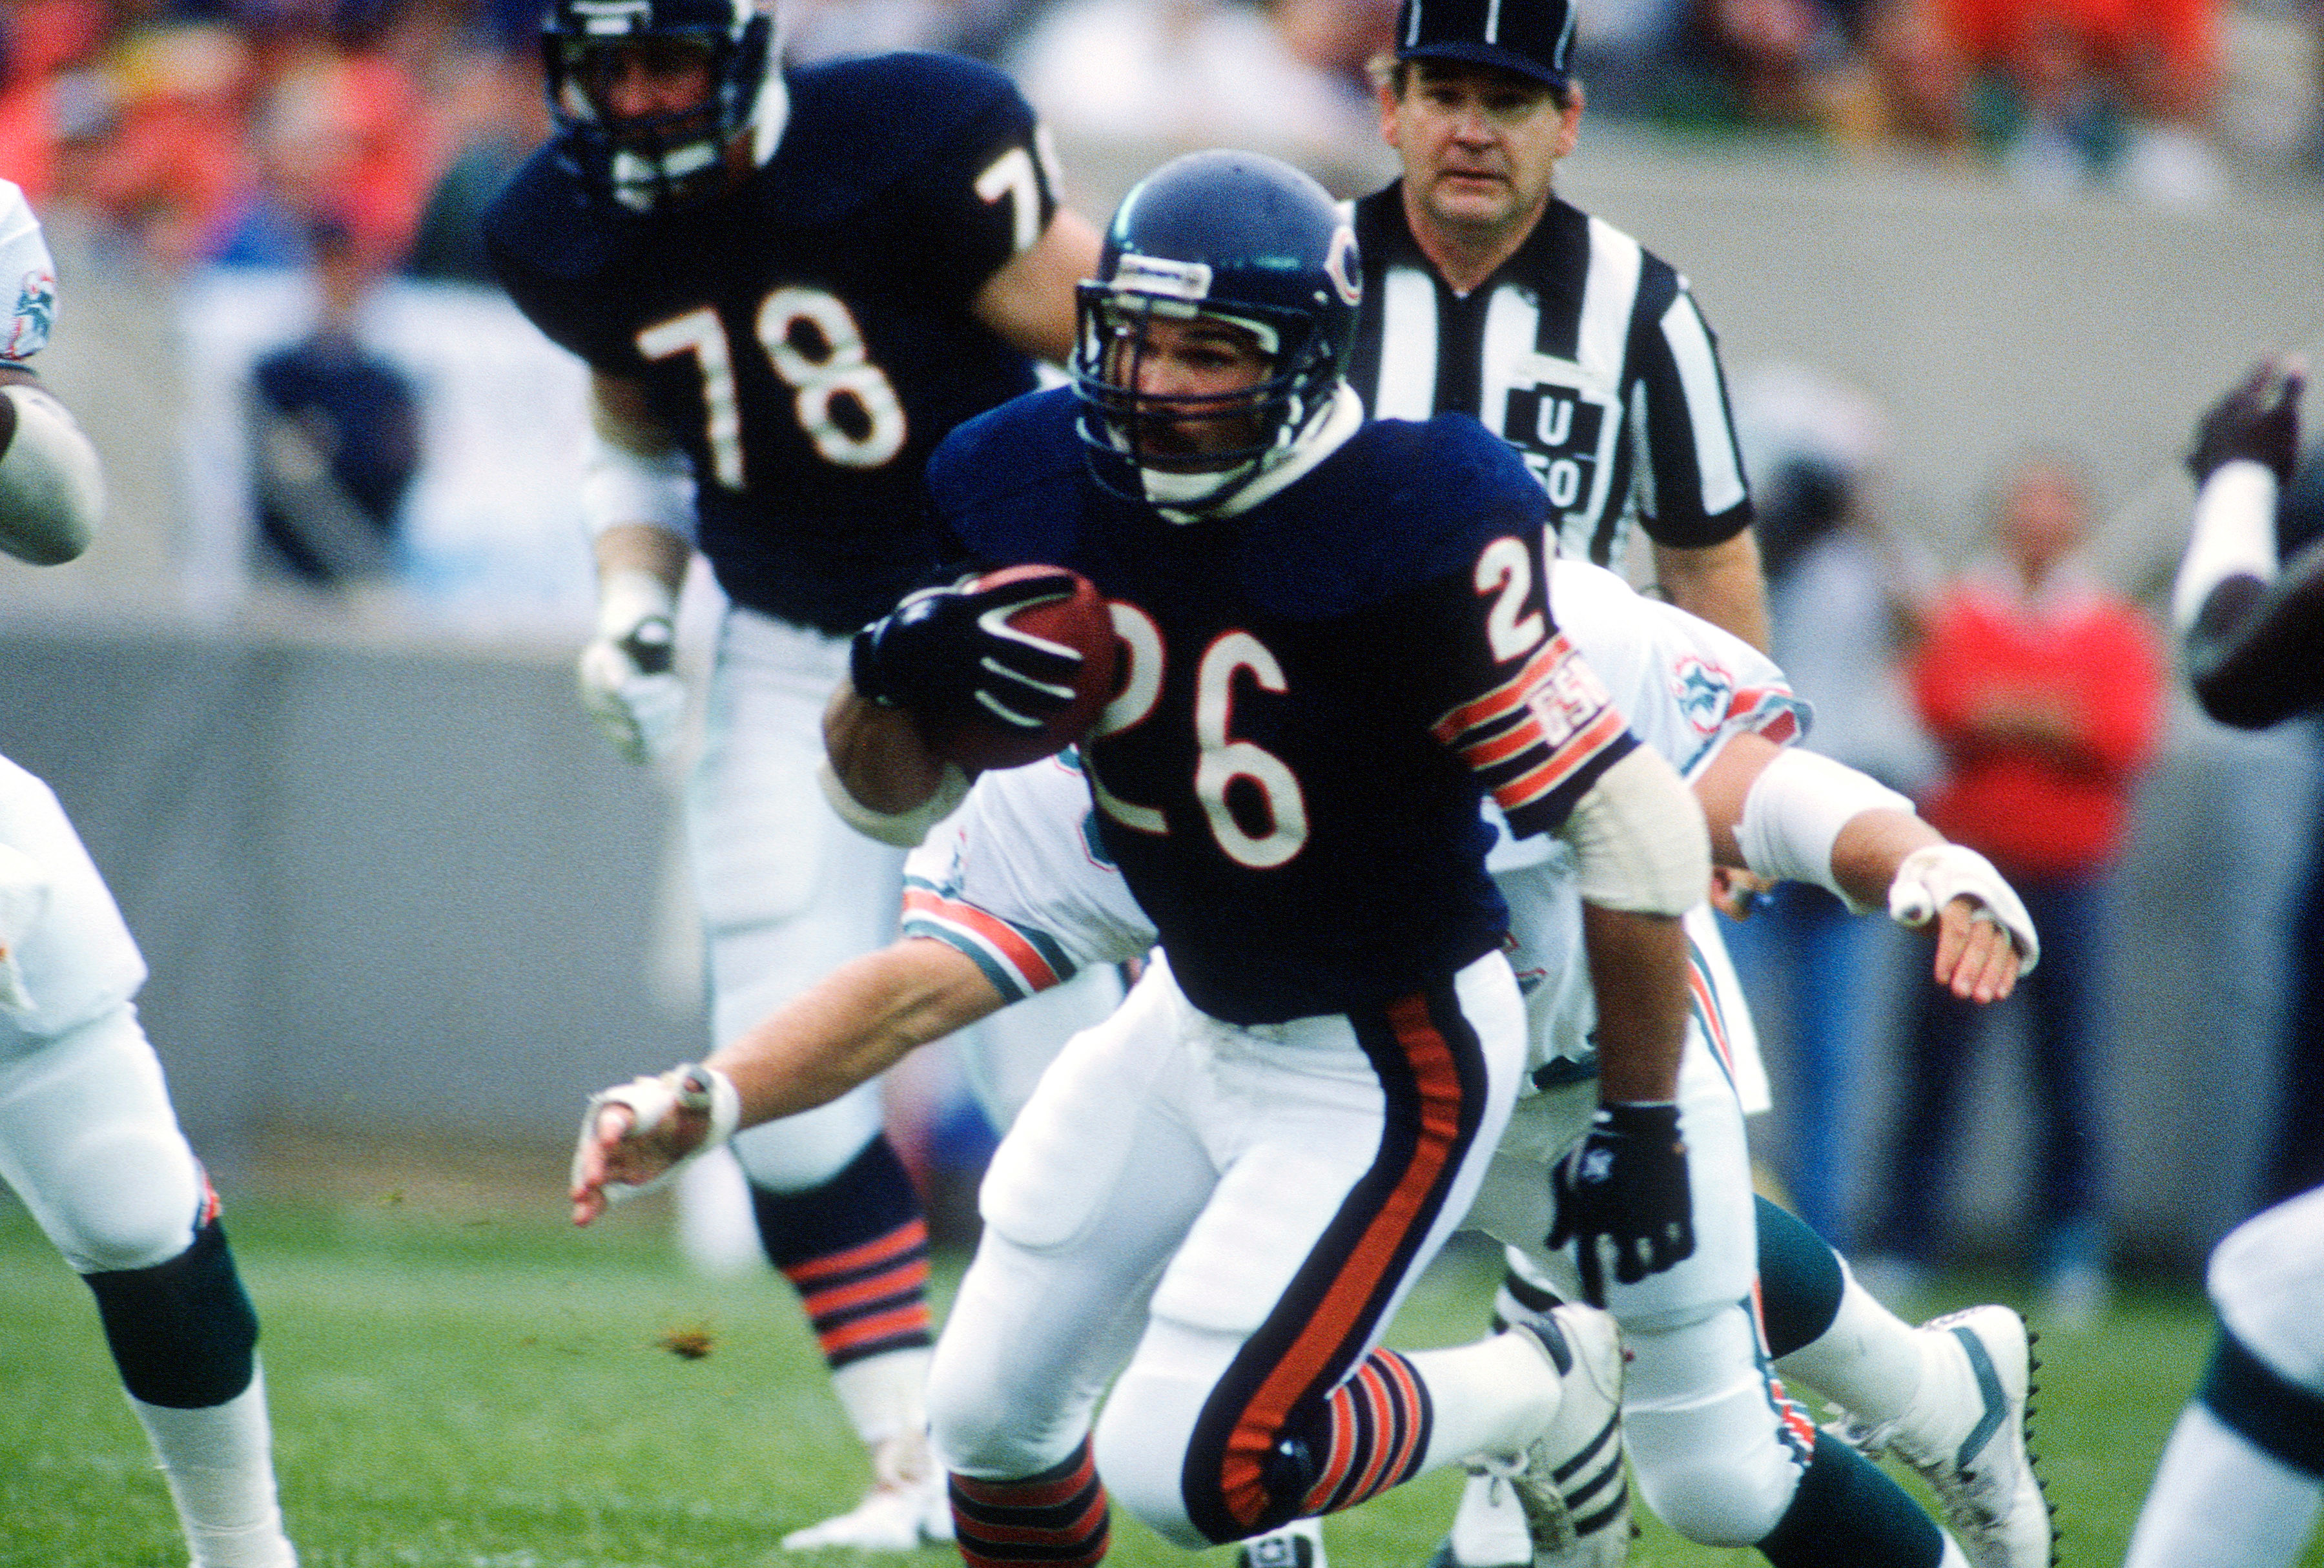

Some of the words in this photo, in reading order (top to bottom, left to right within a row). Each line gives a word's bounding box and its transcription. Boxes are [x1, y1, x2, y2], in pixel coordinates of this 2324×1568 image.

[974, 124, 1063, 252] 7
[635, 284, 909, 492] 78
[1537, 395, 1574, 447] U
[1473, 521, 1560, 665] 2
[1082, 598, 1310, 870] 26
